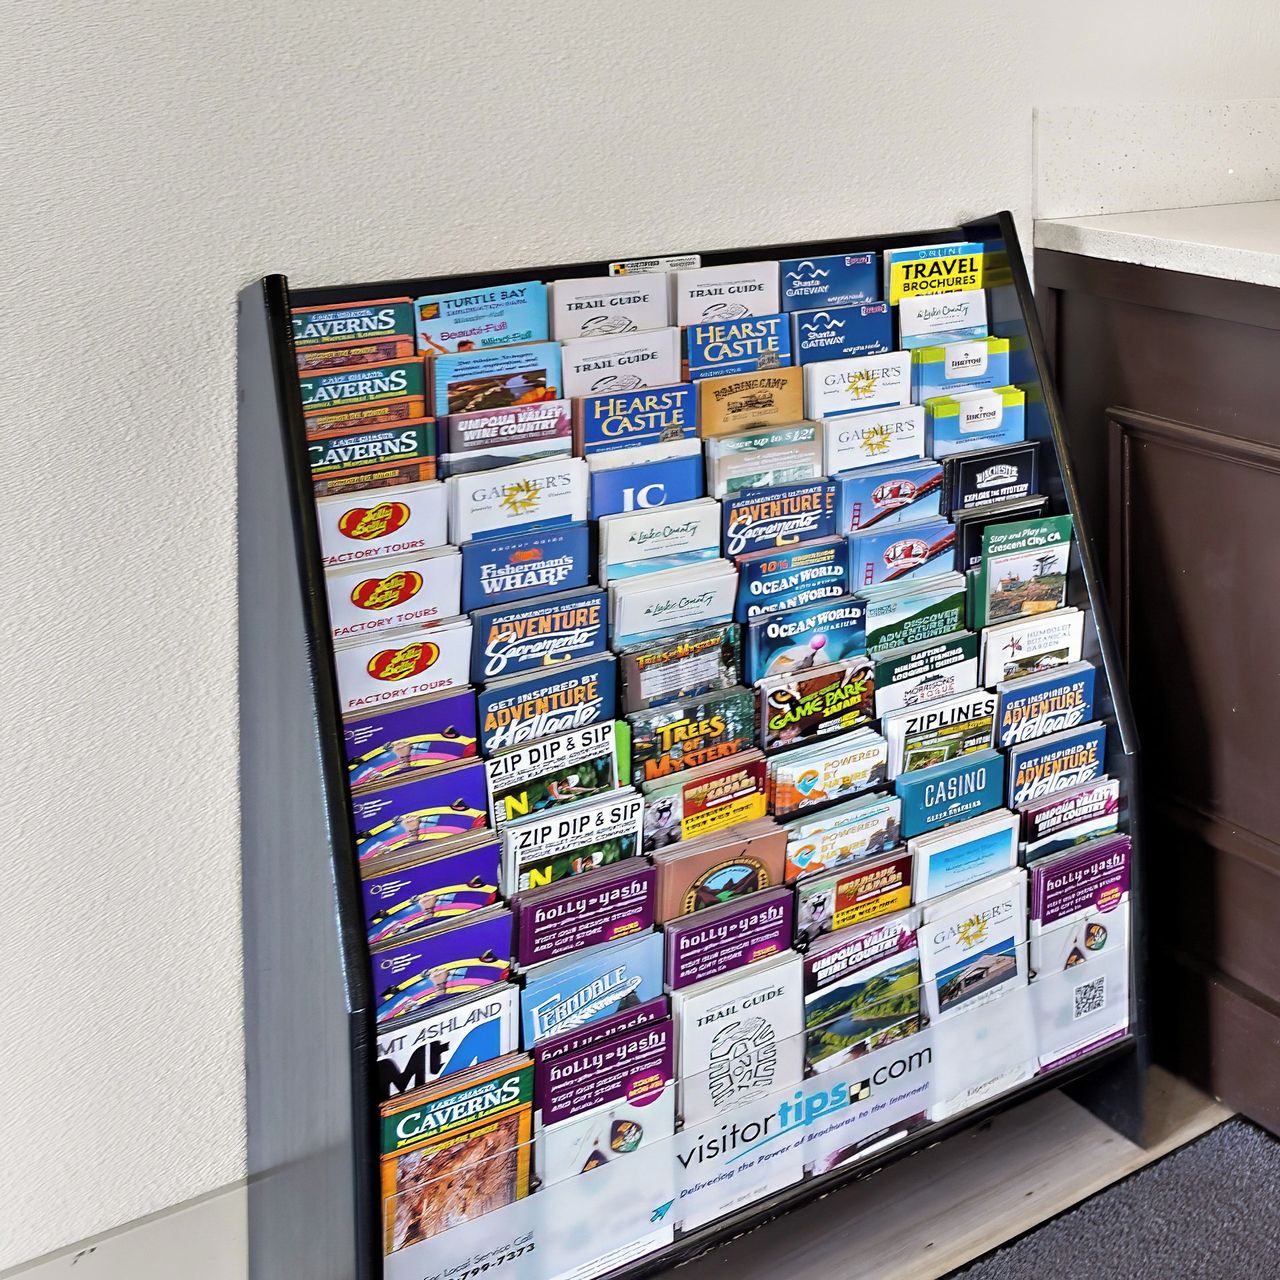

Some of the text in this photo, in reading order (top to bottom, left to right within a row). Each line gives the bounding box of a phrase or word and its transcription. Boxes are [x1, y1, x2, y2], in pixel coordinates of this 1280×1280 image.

[902, 257, 978, 280] TRAVEL
[903, 275, 976, 291] BROCHURES
[443, 293, 496, 309] TURTLE
[501, 288, 526, 300] BAY
[566, 294, 650, 311] TRAIL GUIDE
[688, 283, 765, 298] TRAIL GUIDE
[786, 285, 829, 296] GATEWAY
[696, 318, 781, 345] HEARST
[801, 335, 845, 349] GATEWAY
[574, 352, 659, 373] TRAIL GUIDE
[703, 337, 780, 362] CASTLE
[759, 378, 788, 391] CAMP
[594, 391, 688, 419] HEARST
[499, 418, 559, 436] COUNTRY
[601, 409, 685, 436] CASTLE
[729, 492, 822, 526] ADVENTURE
[727, 509, 823, 555] Sacramento
[988, 538, 1027, 554] Crescent
[1047, 531, 1061, 542] CA
[1008, 531, 1021, 540] and
[1022, 526, 1039, 537] Play
[321, 539, 425, 566] FACTORY TOURS
[480, 554, 574, 580] Fisherman's
[480, 566, 573, 595] WHARF
[750, 565, 844, 595] OCEAN WORLD
[798, 586, 843, 607] WORLD
[334, 607, 438, 637] FACTORY TOURS
[487, 606, 601, 646] ADVENTURE
[767, 616, 816, 638] OCEAN
[815, 607, 862, 624] WORLD
[907, 624, 957, 644] COUNTRY
[484, 625, 601, 676] Sacramento
[348, 677, 453, 709] FACTORY TOURS
[484, 681, 600, 733] ADVENTURE
[487, 673, 599, 713] GET INSPIRED BY
[769, 697, 824, 730] GAME
[825, 680, 867, 706] PARK
[1002, 690, 1083, 726] ADVENTURE
[1007, 681, 1085, 710] GET INSPIRED BY
[905, 699, 995, 735] ZIPLINES
[656, 716, 725, 751] TREES
[682, 738, 701, 753] OF
[490, 725, 612, 779] ZIP DIP & SIP
[645, 737, 749, 781] MYSTERY
[824, 748, 880, 772] POWERED
[1016, 747, 1097, 786] ADVENTURE
[1020, 739, 1099, 770] GET INSPIRED BY
[823, 769, 836, 778] BY
[924, 768, 987, 808] CASINO
[519, 802, 641, 849] ZIP DIP & SIP
[821, 820, 879, 843] POWERED
[820, 840, 835, 852] BY
[535, 879, 648, 924] holly yashi
[680, 905, 784, 950] holly yashi
[812, 941, 863, 973] UMPQUA
[531, 964, 627, 1042] FERNDALE
[697, 986, 785, 1027] TRAIL GUIDE
[377, 1001, 502, 1056] MT ASHLAND
[550, 1031, 666, 1082] holly yashi
[397, 1076, 520, 1139] CAVERNS
[680, 1169, 736, 1199] Delivering
[737, 1158, 755, 1173] the
[757, 1144, 791, 1166] Power
[793, 1136, 806, 1149] of
[806, 1116, 857, 1143] Brochures
[858, 1110, 870, 1121] to
[870, 1100, 888, 1116] the
[443, 1231, 534, 1278] Local Service Call
